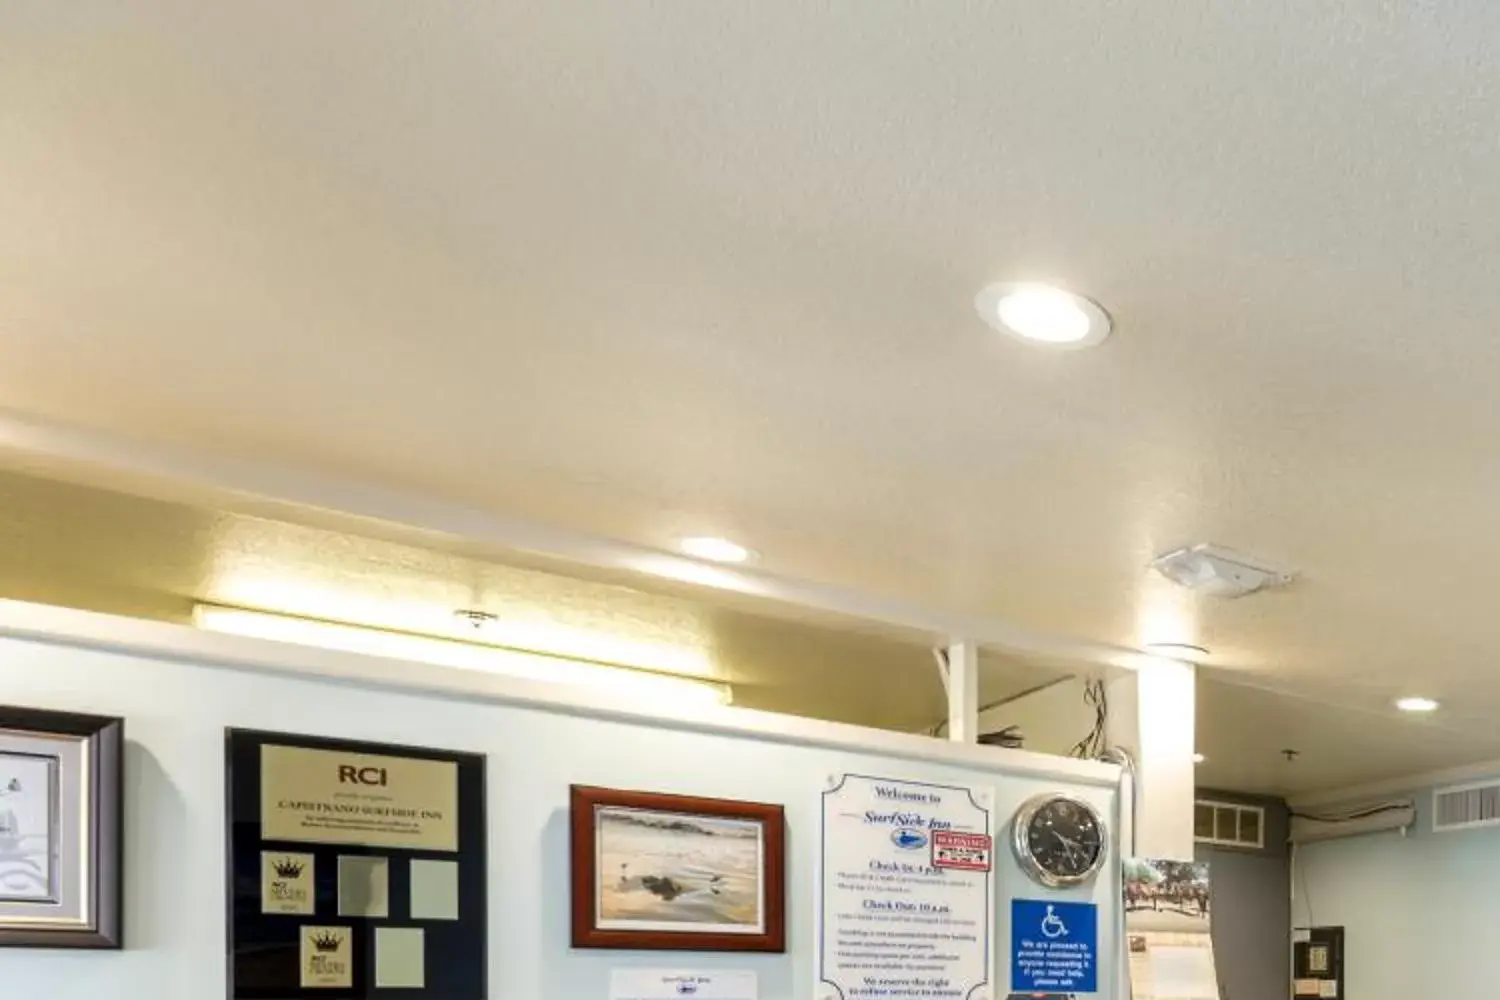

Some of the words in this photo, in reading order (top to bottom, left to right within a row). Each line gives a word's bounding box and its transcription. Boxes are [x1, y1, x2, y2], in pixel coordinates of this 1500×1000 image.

[338, 765, 387, 787] RCI
[875, 786, 926, 802] Welcome
[929, 794, 941, 804] to
[421, 809, 442, 820] INN
[928, 818, 951, 829] Inn
[869, 860, 898, 872] Check
[862, 899, 893, 910] Check
[1021, 939, 1034, 947] We
[1018, 950, 1045, 958] provide
[1018, 960, 1044, 968] anyone
[863, 977, 876, 985] We
[928, 979, 949, 987] right
